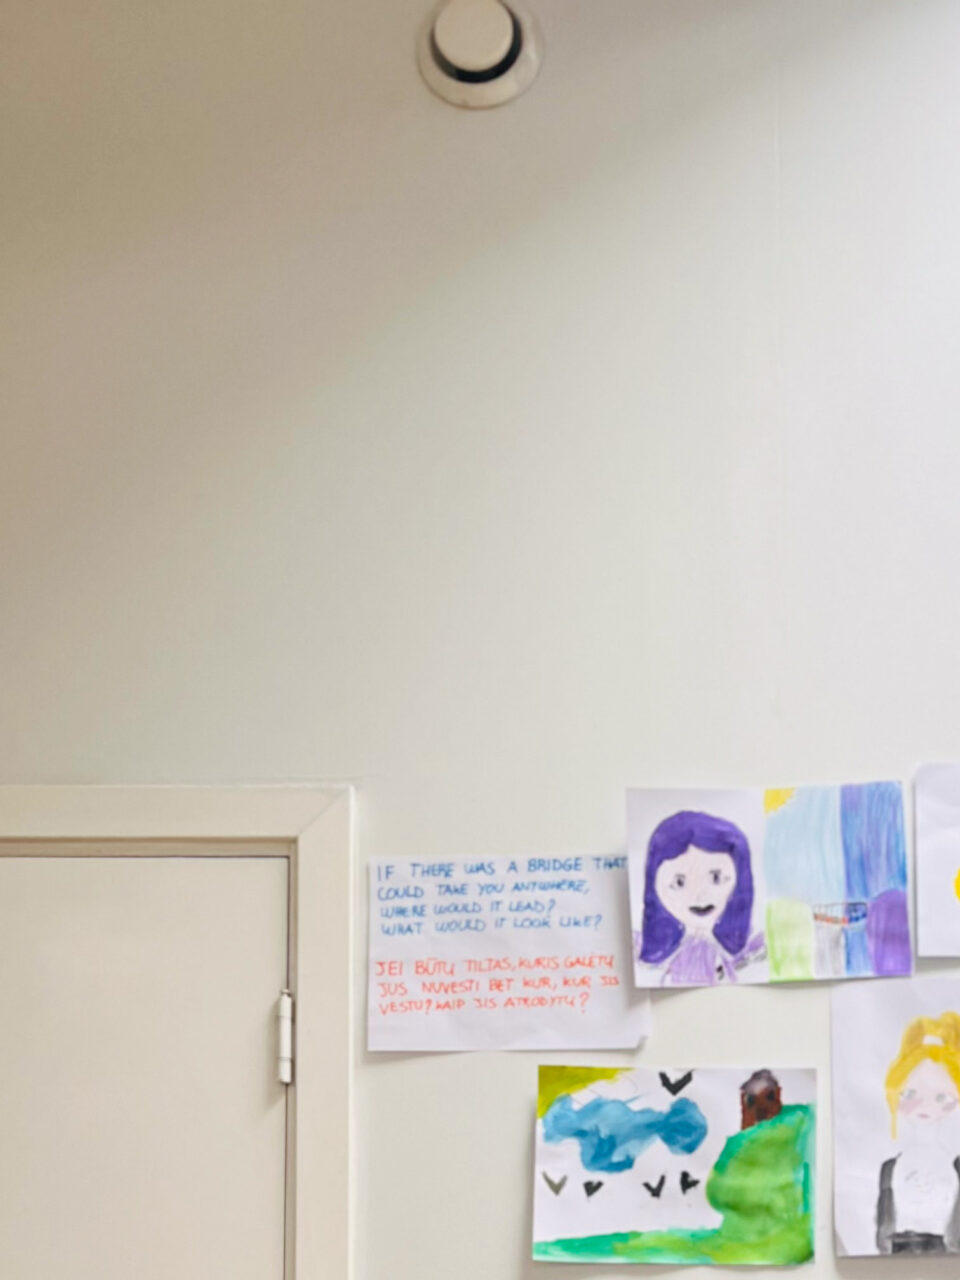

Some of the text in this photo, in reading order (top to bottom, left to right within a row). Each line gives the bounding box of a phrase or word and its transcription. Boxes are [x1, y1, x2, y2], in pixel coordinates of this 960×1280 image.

[377, 864, 395, 881] IF
[410, 862, 455, 877] THERE
[464, 861, 495, 876] WAS
[506, 860, 518, 874] A
[527, 856, 583, 872] BRIDGE
[377, 885, 424, 901] COULD
[436, 883, 468, 896] TAKE
[478, 883, 504, 896] YOU
[381, 898, 556, 919] WHERE WOULD IT LEAD?
[381, 921, 423, 936] WHAT
[435, 919, 486, 933] WOULD
[495, 917, 506, 928] IT
[513, 917, 551, 929] LOOK
[376, 960, 403, 977] JEI
[422, 979, 480, 994] NUVESTI
[488, 978, 514, 992] BET
